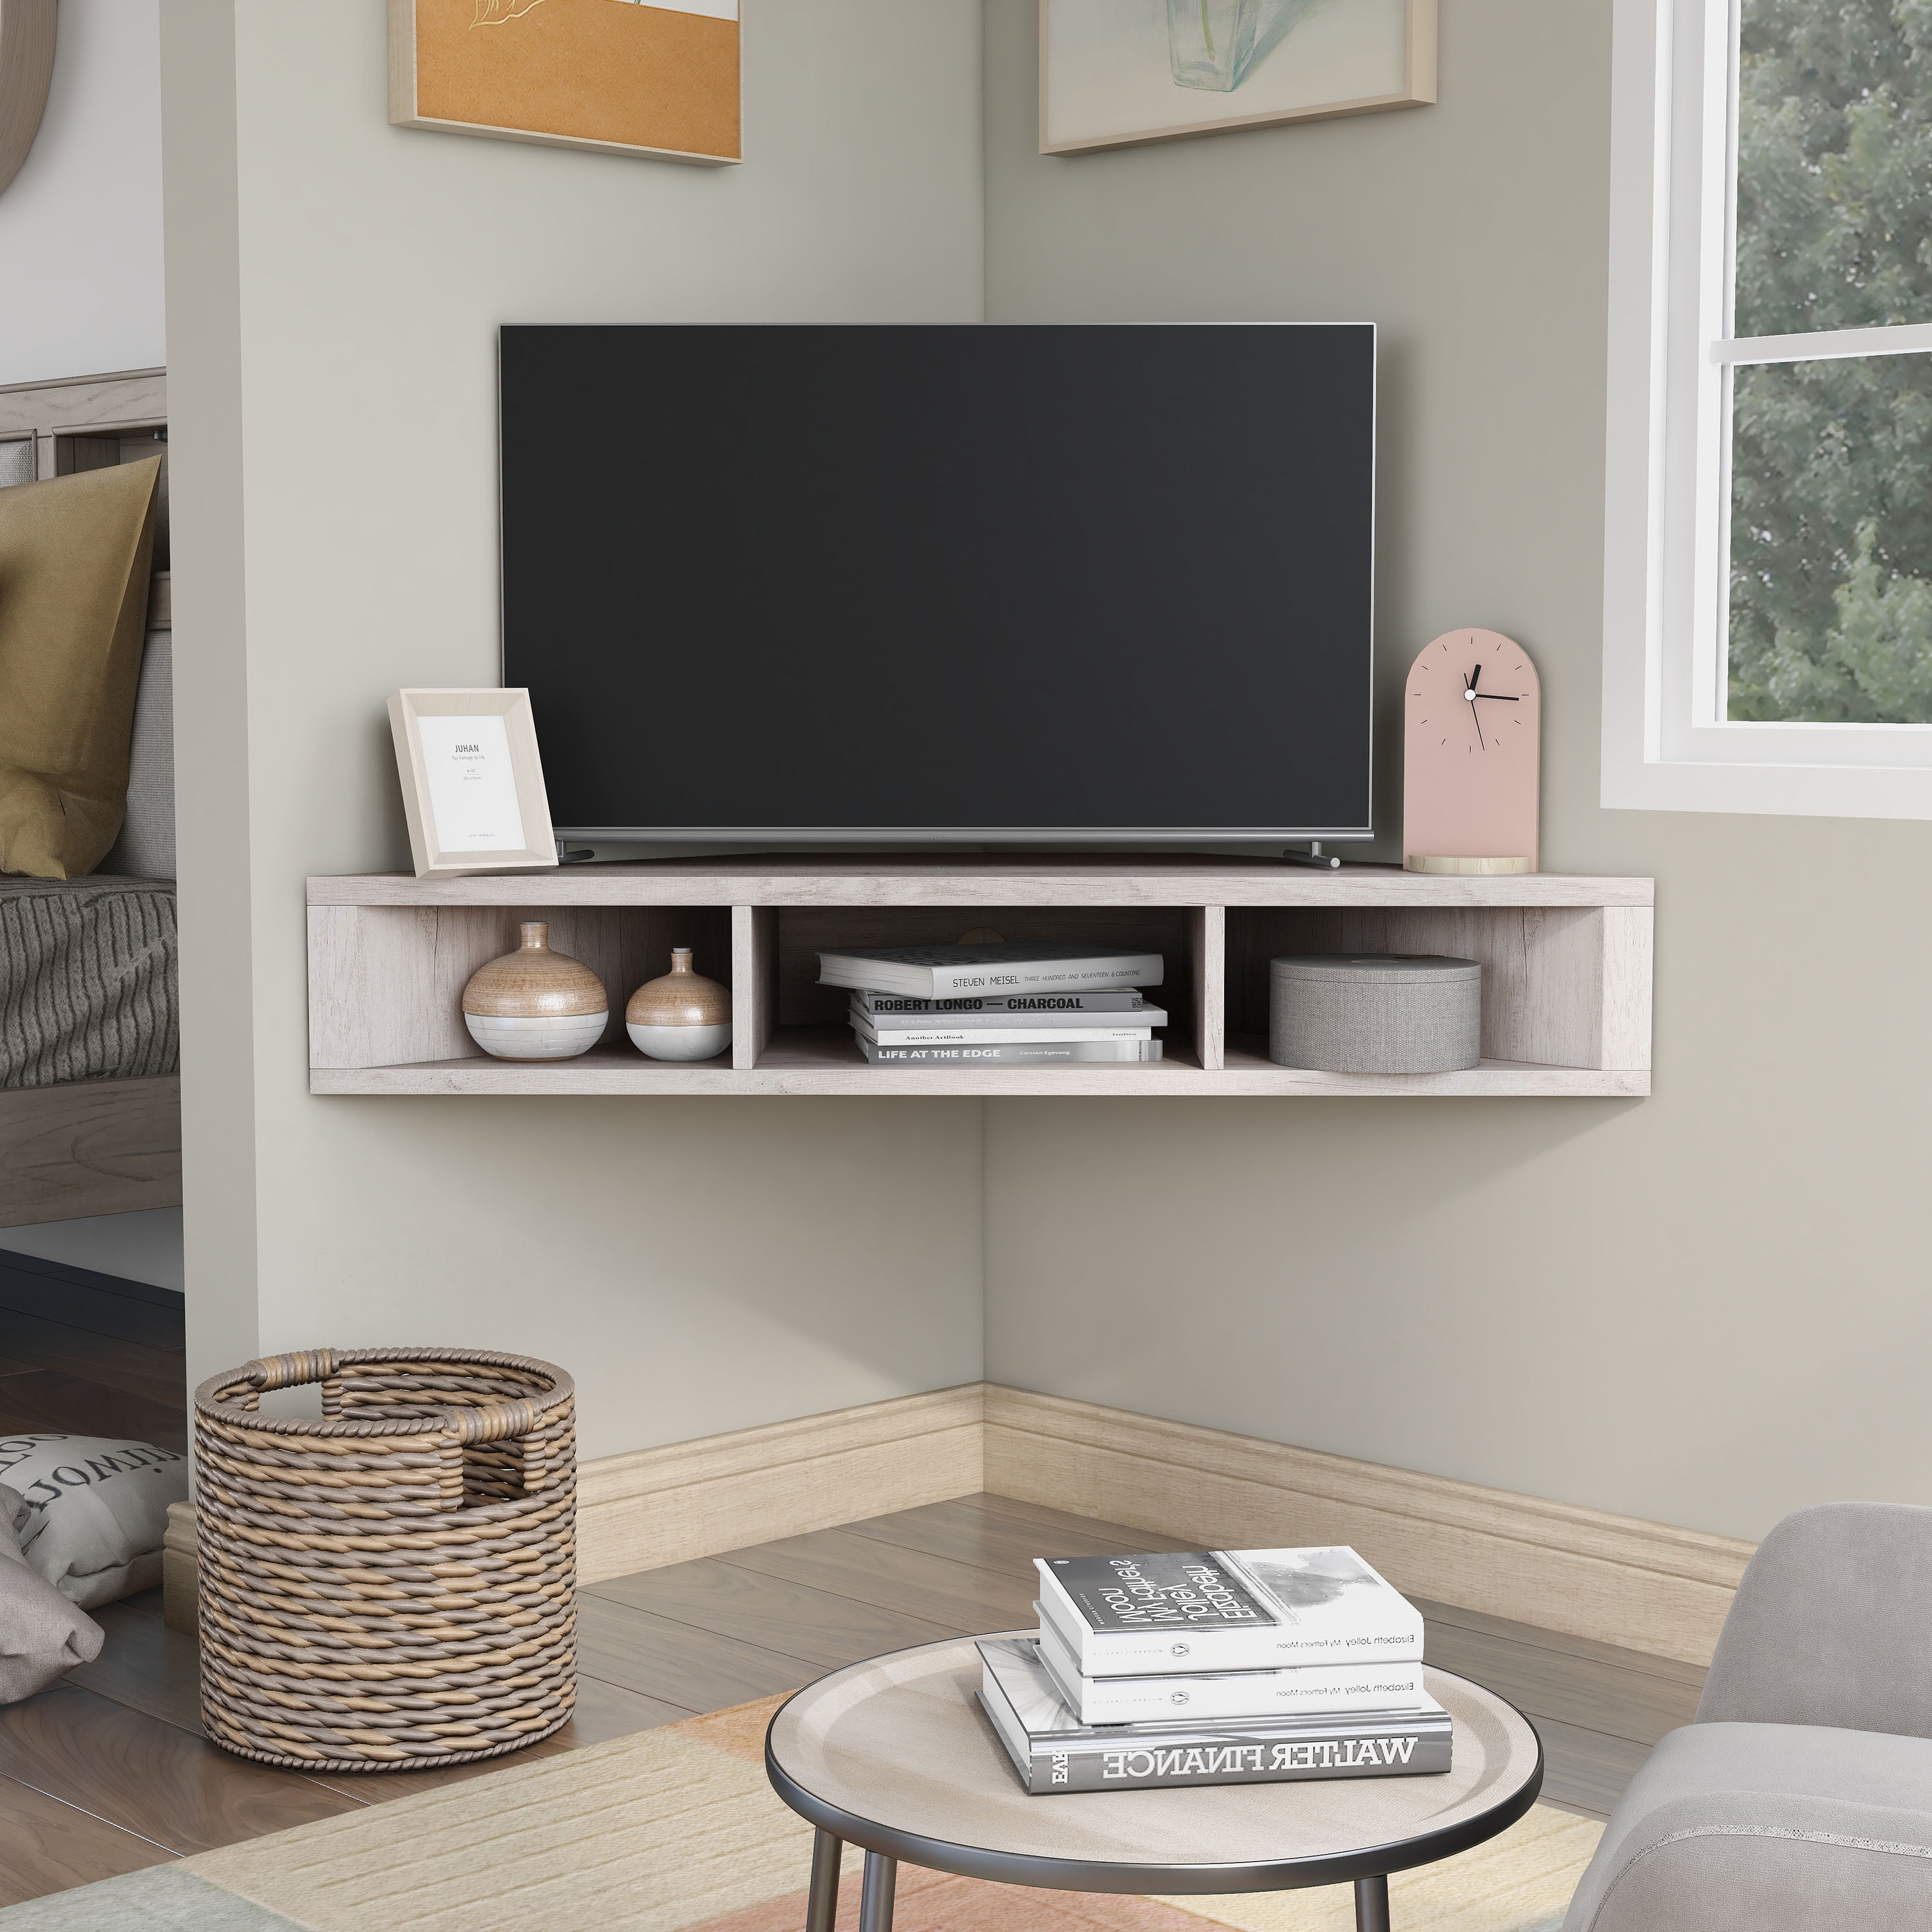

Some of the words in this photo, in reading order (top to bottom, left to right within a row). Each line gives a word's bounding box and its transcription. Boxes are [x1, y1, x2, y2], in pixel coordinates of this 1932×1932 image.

[455, 744, 479, 753] JUHAN
[952, 978, 985, 988] STEVEN
[989, 976, 1019, 985] MEISEL
[875, 999, 932, 1011] ROBERT
[936, 999, 983, 1010] LONGO
[1007, 998, 1084, 1010] CHARCOAL
[878, 1050, 907, 1059] LIFE
[931, 1050, 959, 1058] THE
[963, 1050, 1001, 1058] EDGE
